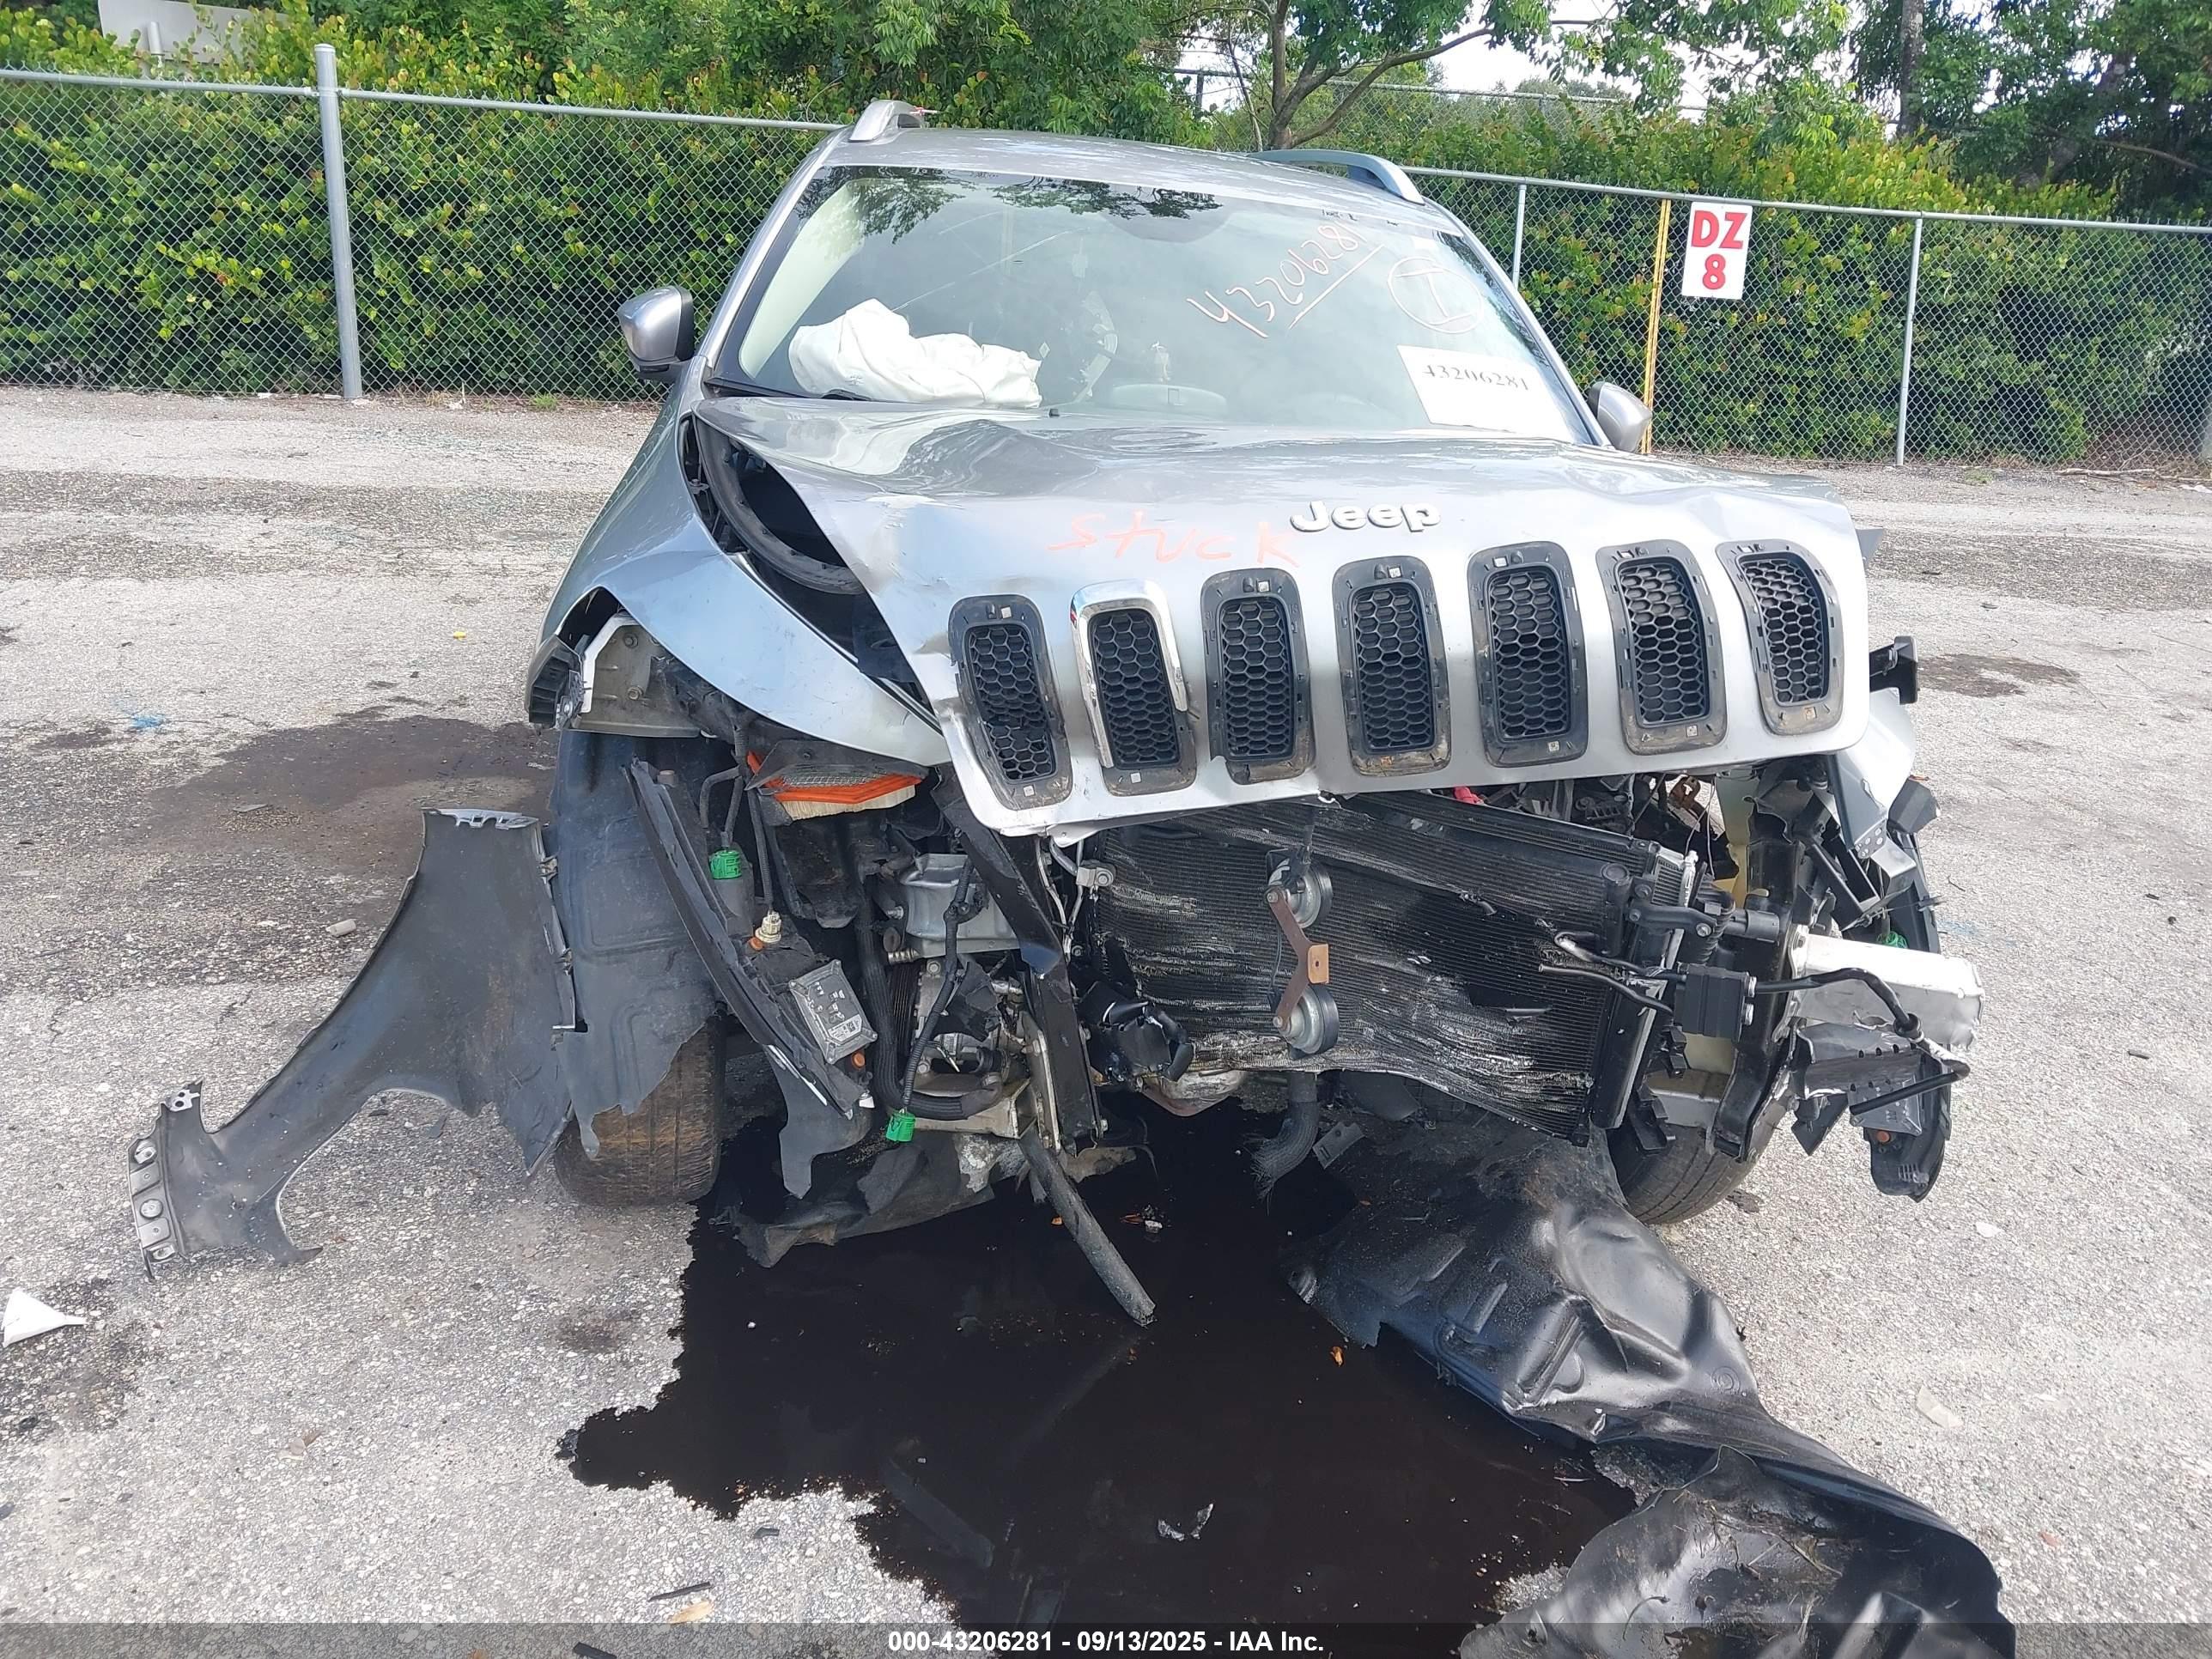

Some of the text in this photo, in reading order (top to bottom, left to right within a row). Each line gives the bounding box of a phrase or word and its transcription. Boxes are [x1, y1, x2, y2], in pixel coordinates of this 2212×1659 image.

[1691, 210, 1748, 250] DZ
[1186, 219, 1369, 338] 43206281
[1702, 253, 1727, 290] 8
[1290, 501, 1442, 533] Jeep
